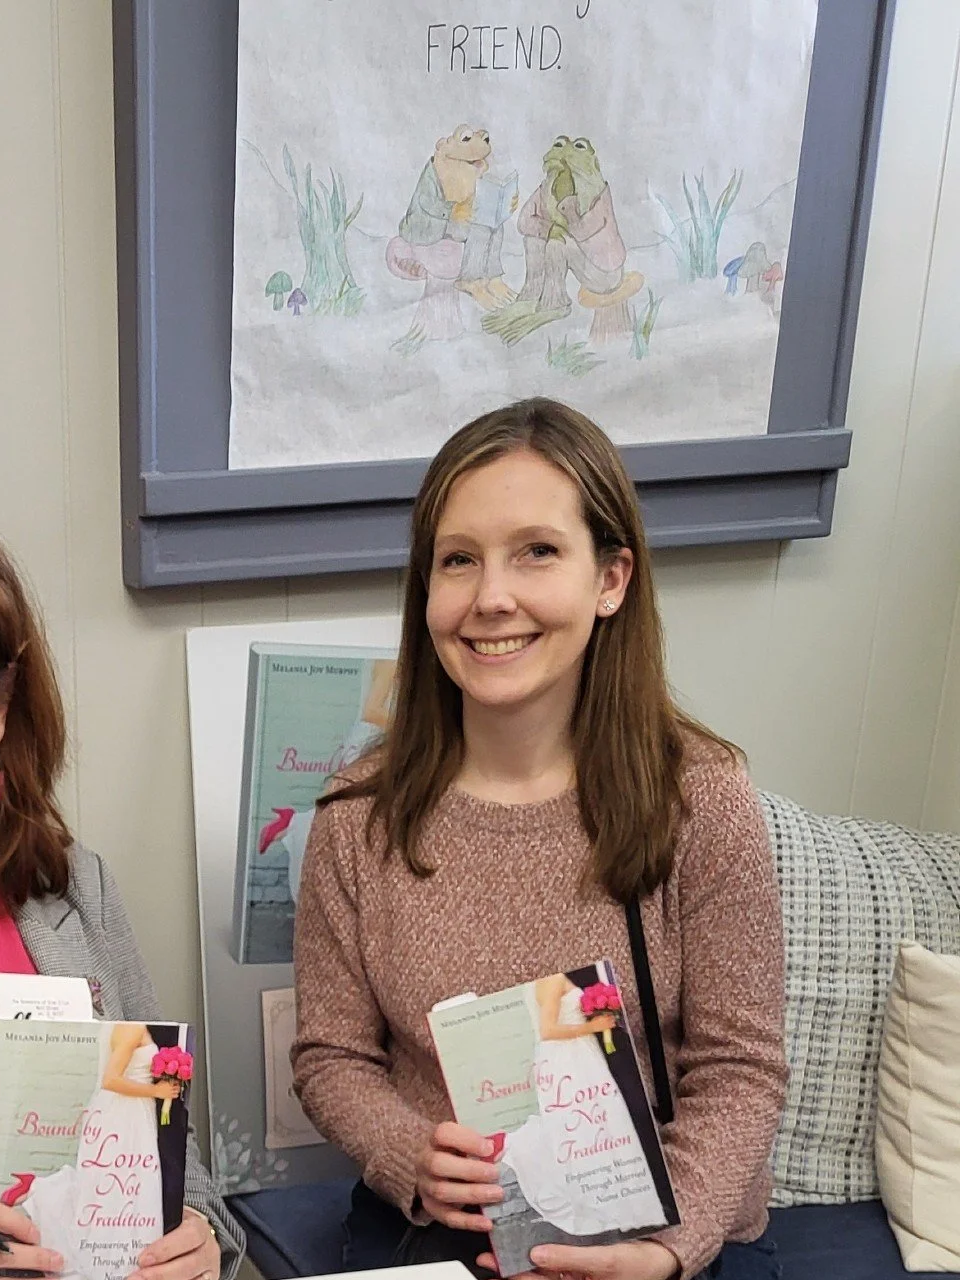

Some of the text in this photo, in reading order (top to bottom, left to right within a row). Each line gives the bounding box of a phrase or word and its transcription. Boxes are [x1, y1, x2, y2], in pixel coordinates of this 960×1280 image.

[428, 24, 562, 73] FRIEND.
[5, 1032, 97, 1044] MELANIA JOY MURPHY
[544, 1075, 619, 1113] Love,
[16, 1105, 103, 1143] Bound by
[564, 1103, 608, 1133] Not
[80, 1134, 159, 1173] Love,
[556, 1127, 632, 1165] Tradition
[95, 1172, 141, 1197] Not
[77, 1201, 157, 1228] Tradition
[92, 1256, 126, 1269] Through
